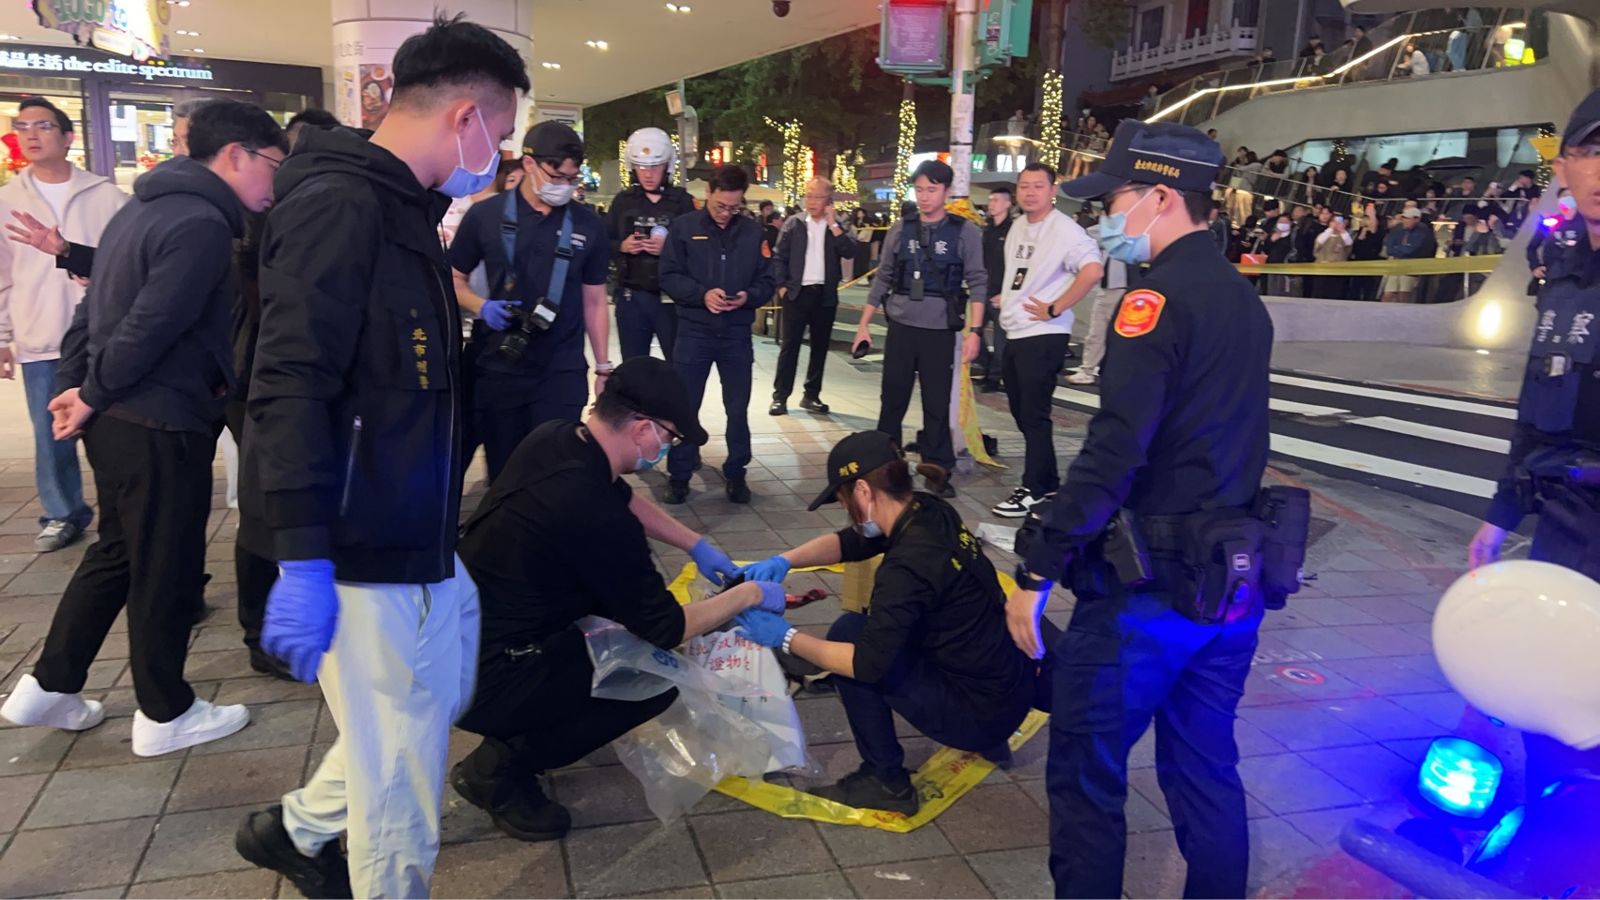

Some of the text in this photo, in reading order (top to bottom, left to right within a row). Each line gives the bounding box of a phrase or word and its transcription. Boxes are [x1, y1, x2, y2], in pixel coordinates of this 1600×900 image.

[64, 56, 93, 72] the
[93, 58, 138, 75] eslite
[139, 62, 213, 80] spectrum
